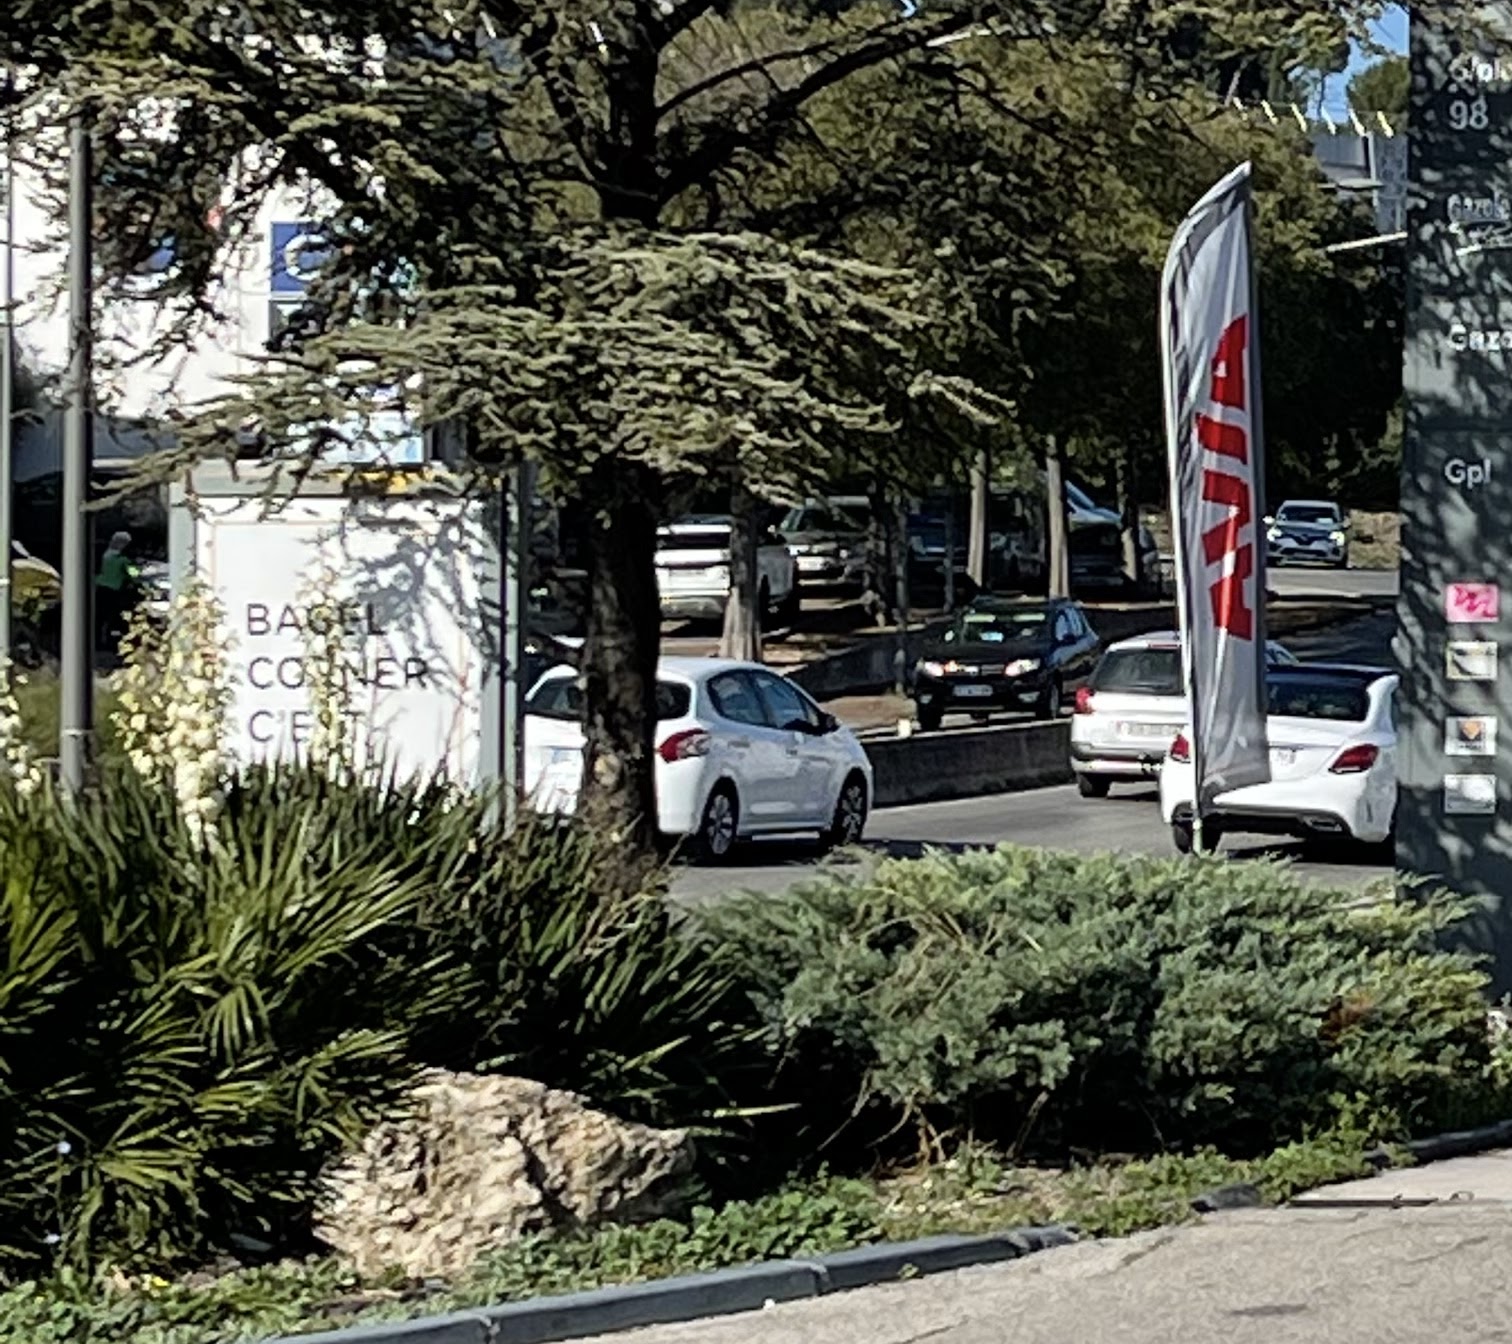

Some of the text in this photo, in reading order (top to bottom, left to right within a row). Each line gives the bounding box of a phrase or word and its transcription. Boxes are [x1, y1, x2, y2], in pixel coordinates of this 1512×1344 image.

[1449, 100, 1489, 130] 98
[1444, 458, 1492, 489] Gpl
[248, 656, 429, 690] CONER
[248, 709, 366, 743] C'ET
